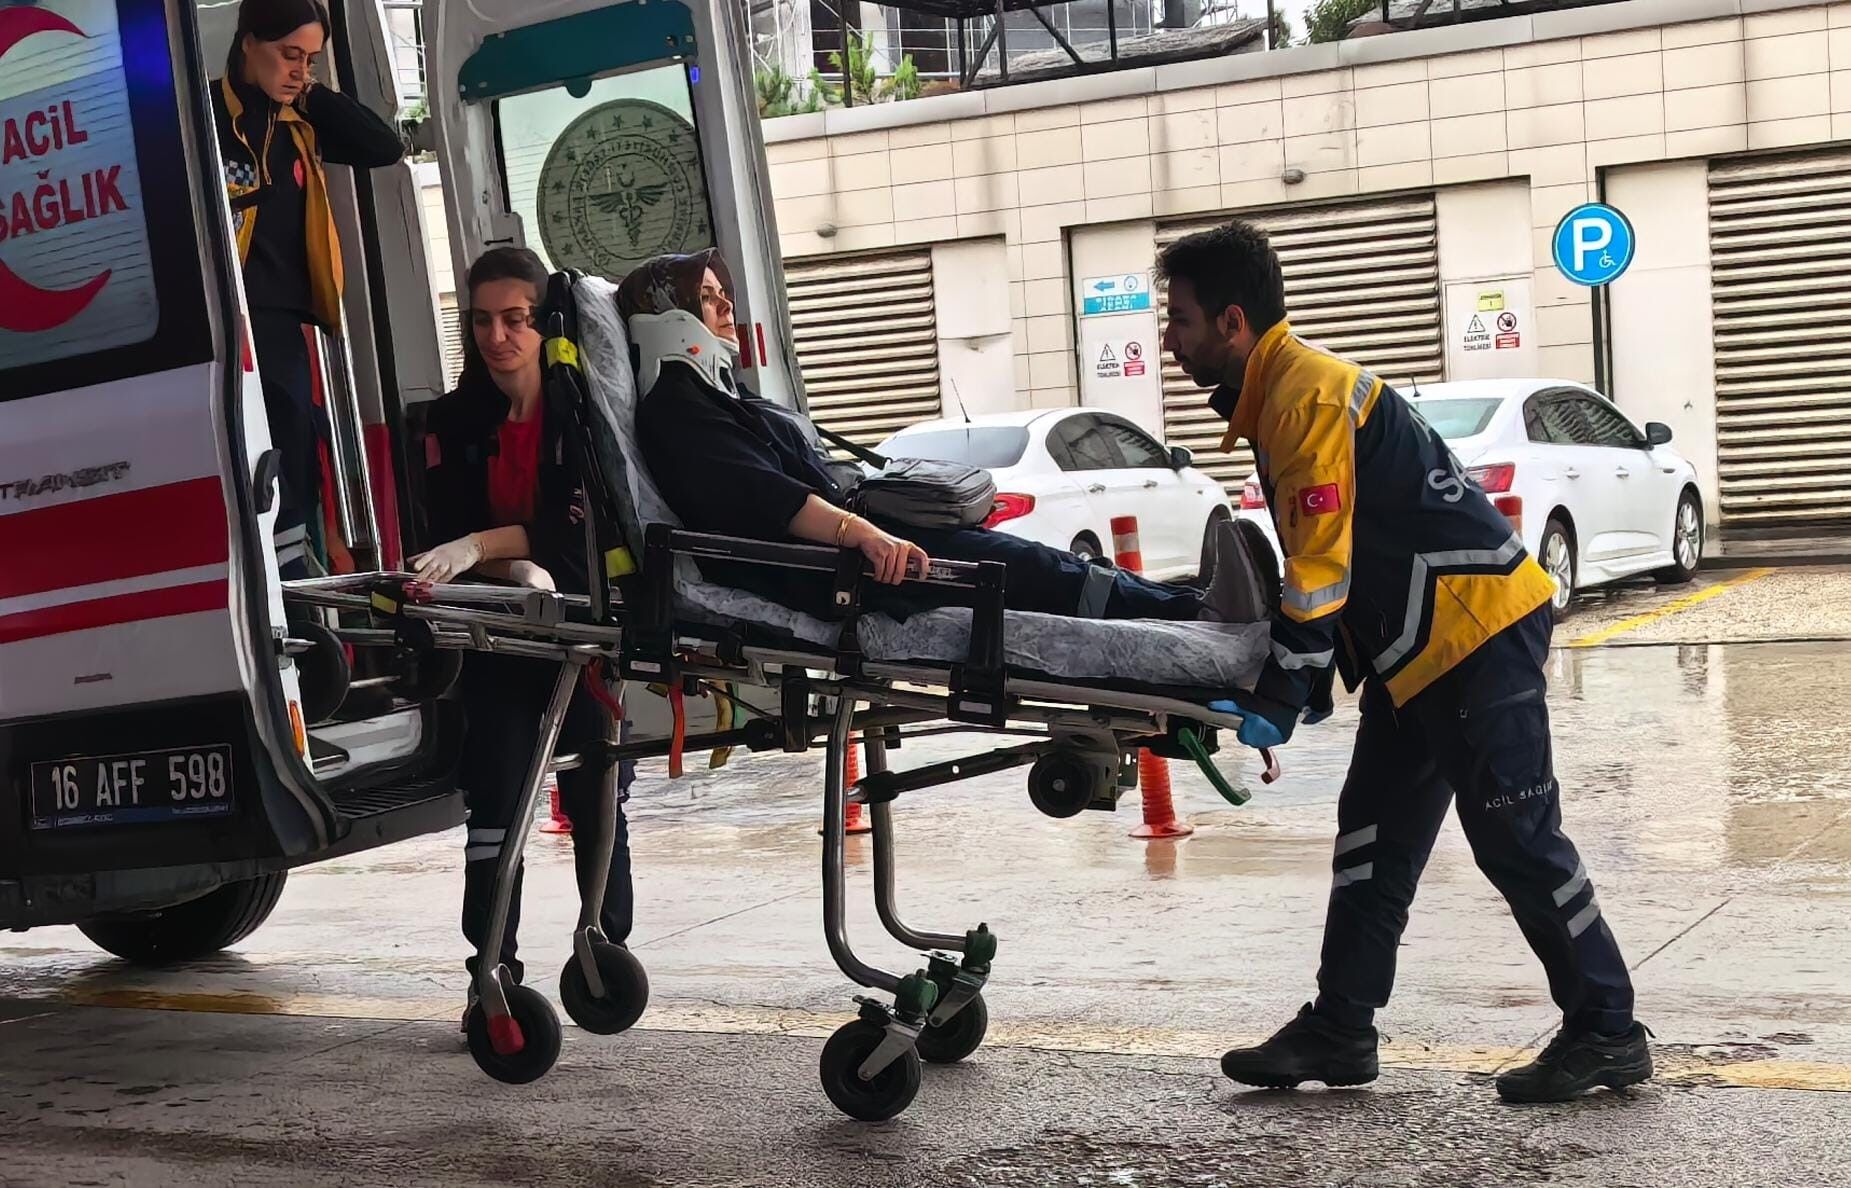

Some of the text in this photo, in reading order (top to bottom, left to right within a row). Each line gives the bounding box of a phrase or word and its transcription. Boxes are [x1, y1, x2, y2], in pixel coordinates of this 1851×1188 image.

[2, 100, 88, 164] ACİL
[1573, 217, 1613, 272] P
[52, 752, 226, 810] 16 AFF 598
